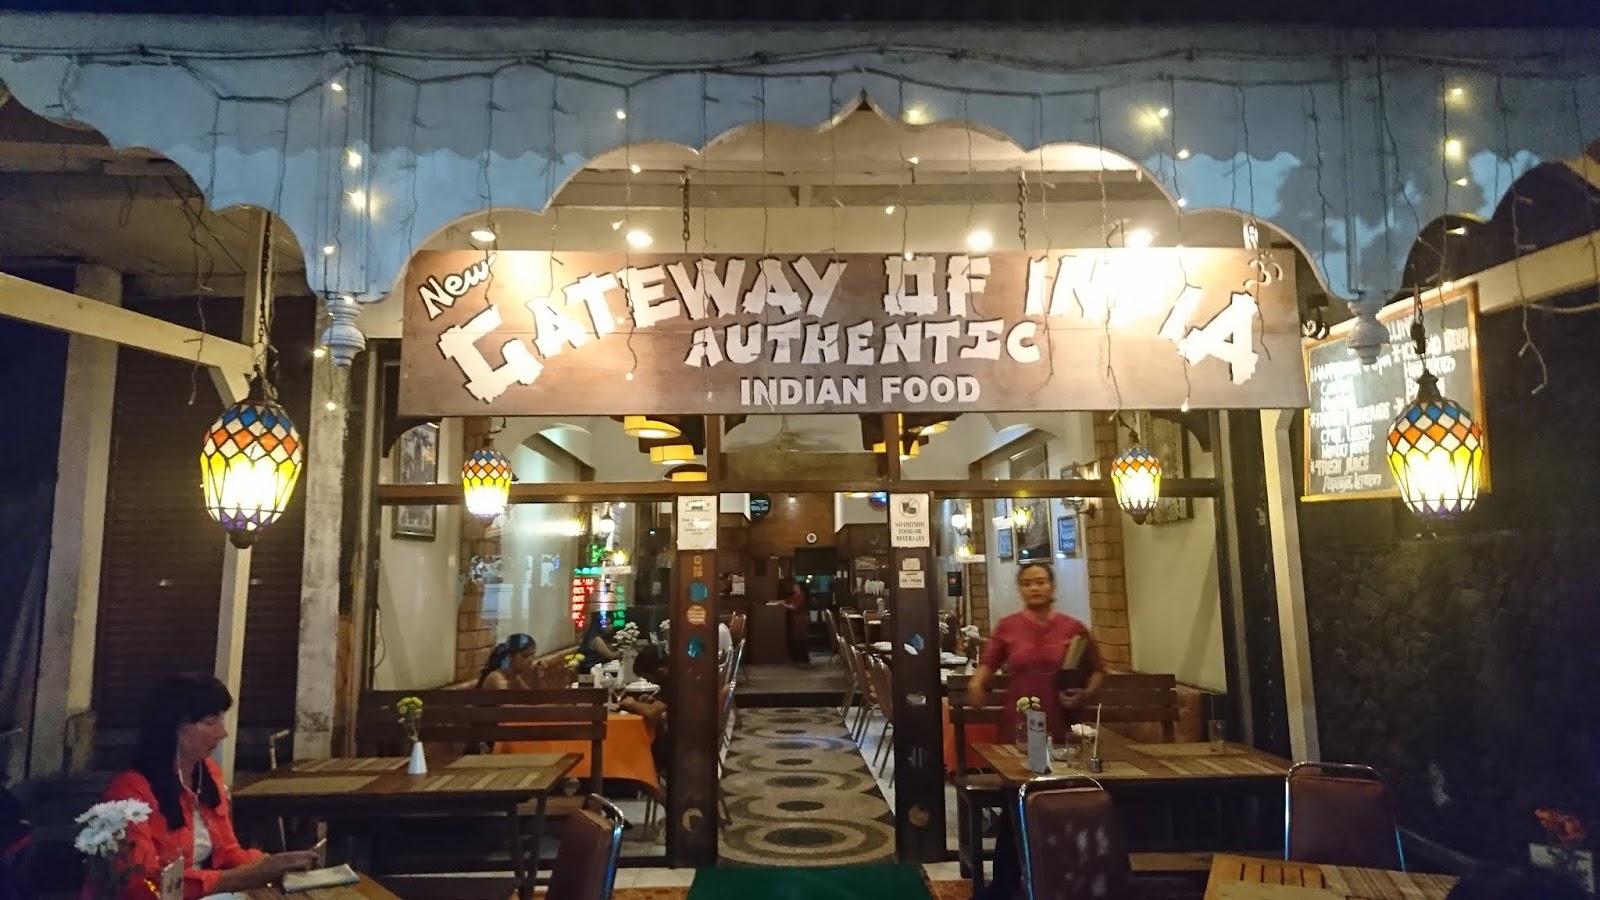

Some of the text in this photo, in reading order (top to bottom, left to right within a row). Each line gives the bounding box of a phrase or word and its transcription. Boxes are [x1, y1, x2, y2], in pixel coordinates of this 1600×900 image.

[418, 253, 497, 320] New
[437, 254, 1259, 403] GATEWAY OF INIA
[685, 318, 1041, 368] AUTHENTIC
[740, 376, 981, 406] INDIAN FOOD
